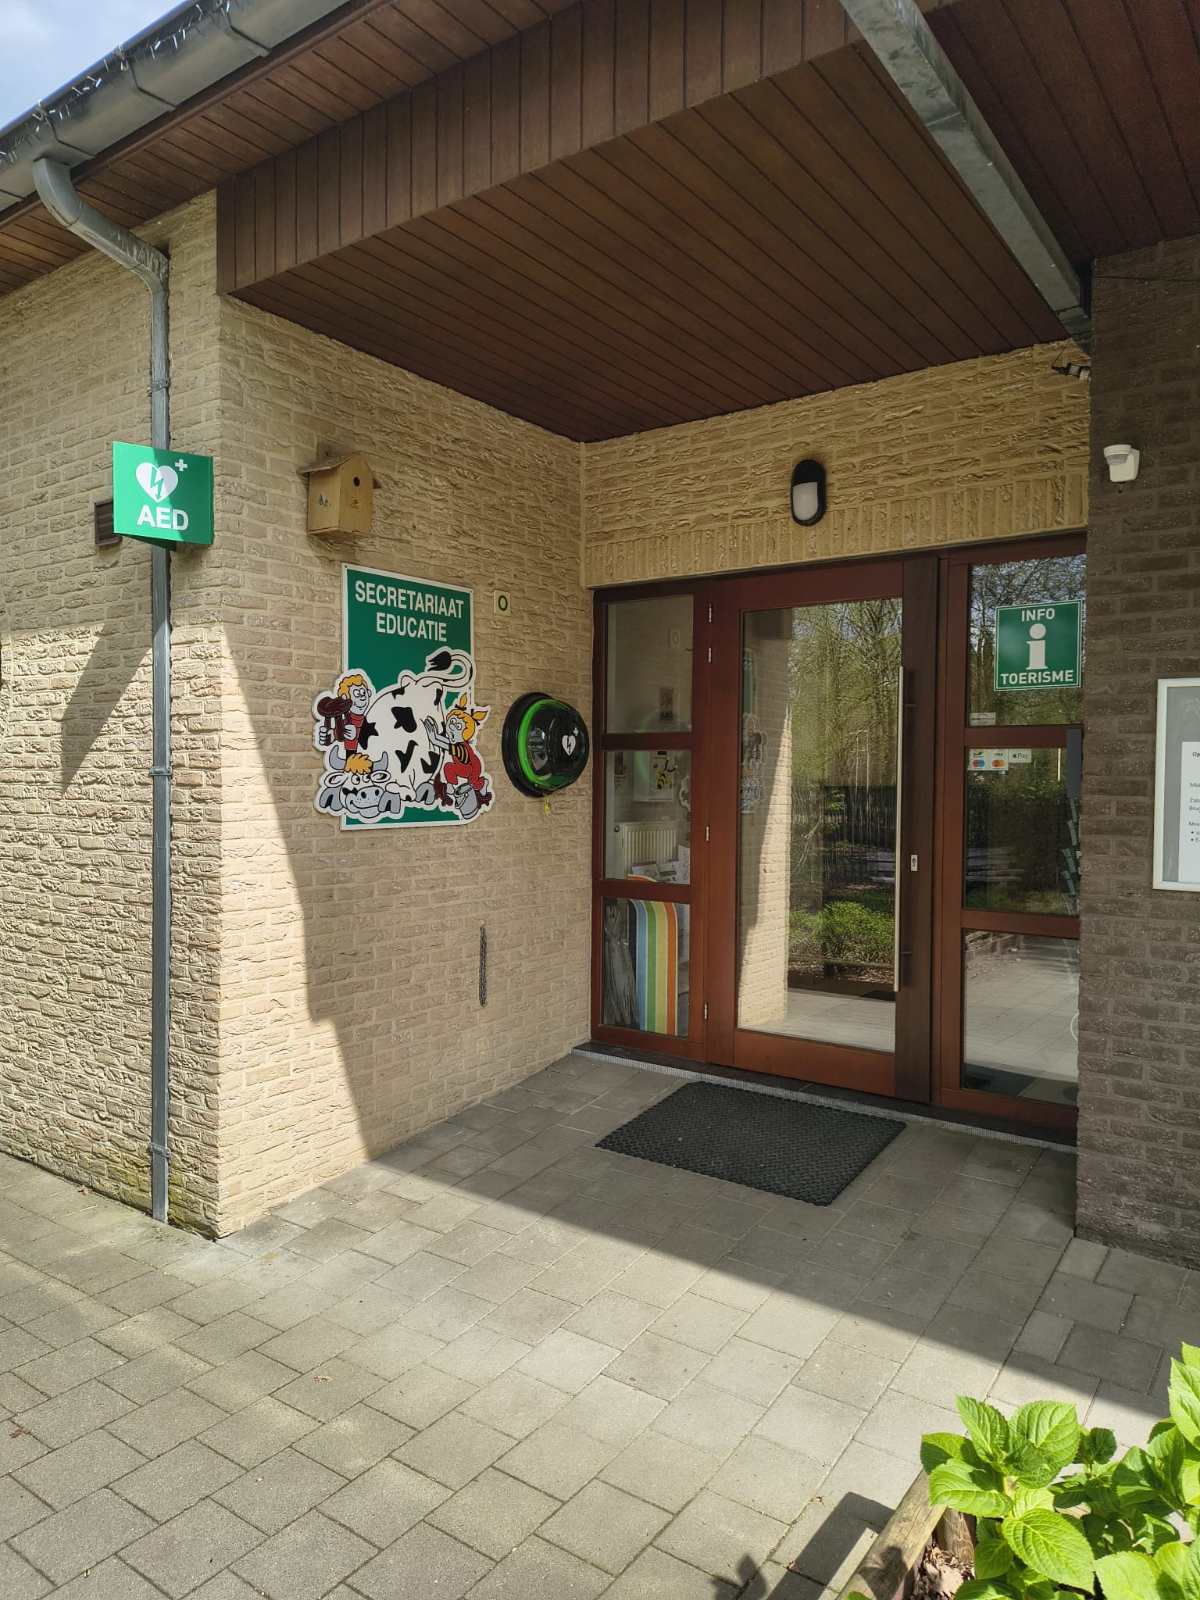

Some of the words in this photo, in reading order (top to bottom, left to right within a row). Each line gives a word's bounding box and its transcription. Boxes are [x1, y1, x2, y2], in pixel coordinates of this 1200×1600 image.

[136, 504, 189, 531] AED
[355, 580, 464, 619] SECRETARIAAT
[376, 612, 447, 642] EDUCATIE
[1021, 608, 1055, 622] INFO
[1001, 669, 1074, 685] TOERISME
